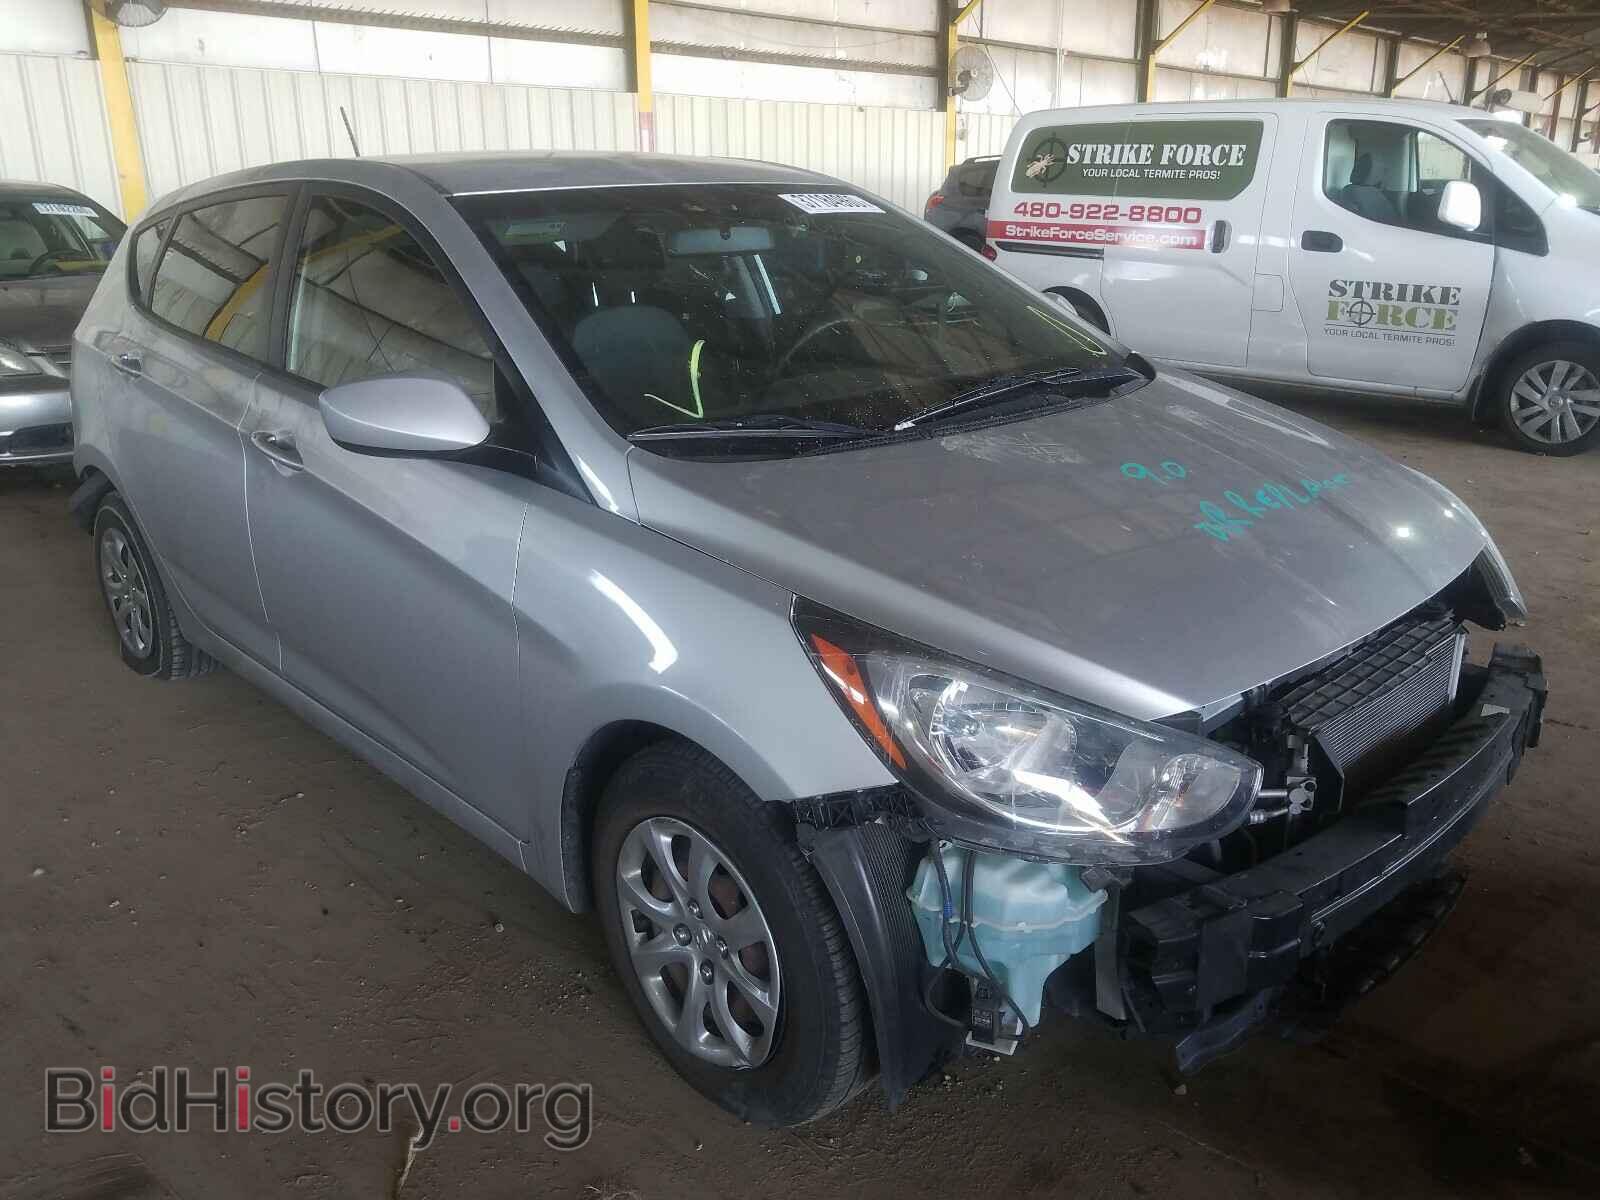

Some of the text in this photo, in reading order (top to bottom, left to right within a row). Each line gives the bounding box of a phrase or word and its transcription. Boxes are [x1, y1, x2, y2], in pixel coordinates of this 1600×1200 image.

[1067, 143, 1246, 167] STRIKE FORCE
[1082, 168, 1220, 180] YOUR LOCAL TERMITE PROS!
[1014, 202, 1202, 223] 480-922-8800
[1005, 224, 1197, 245] StrikeForceService.com
[1328, 279, 1462, 305] STRIKE
[1324, 328, 1348, 337] YOUR
[1351, 331, 1379, 340] LOCAL
[1383, 333, 1423, 344] TERMITE
